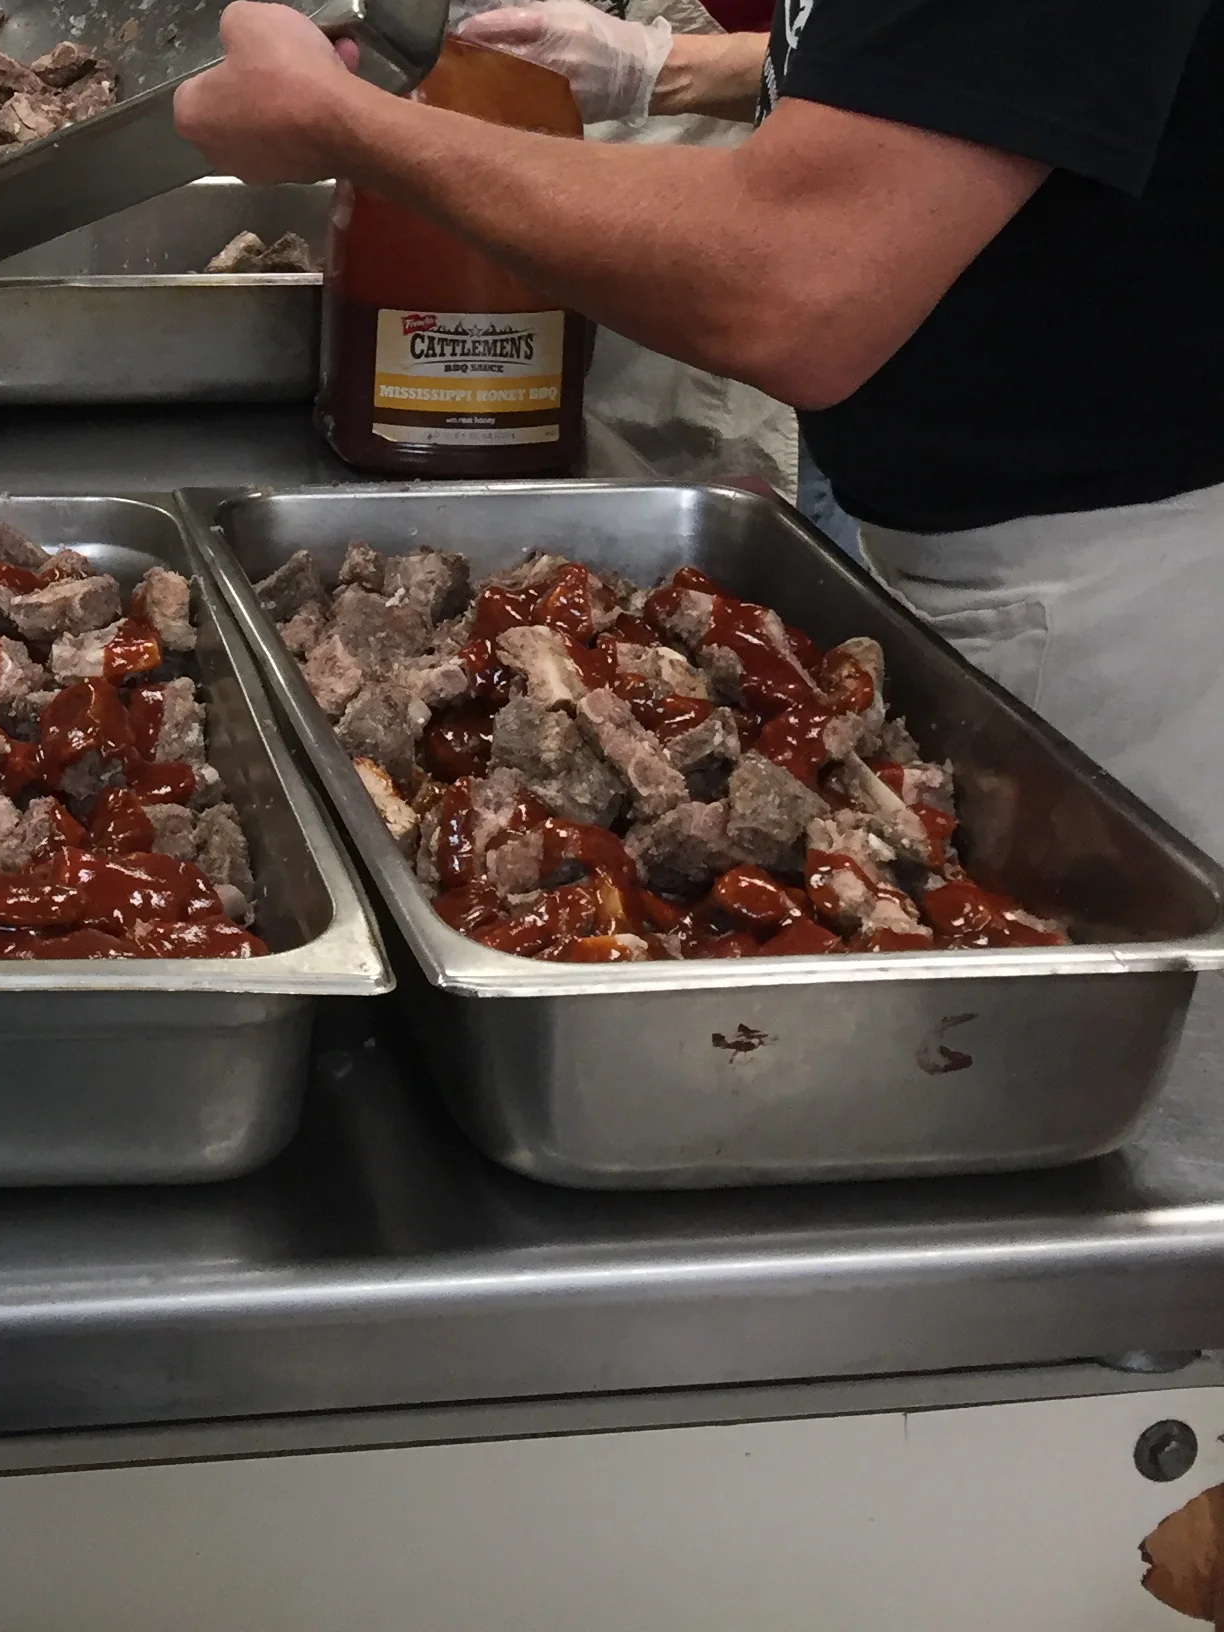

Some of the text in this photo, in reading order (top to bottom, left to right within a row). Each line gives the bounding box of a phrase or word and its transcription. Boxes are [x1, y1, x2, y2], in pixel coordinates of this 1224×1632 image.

[379, 385, 558, 402] MISSISSIPPI HONEY BBQ
